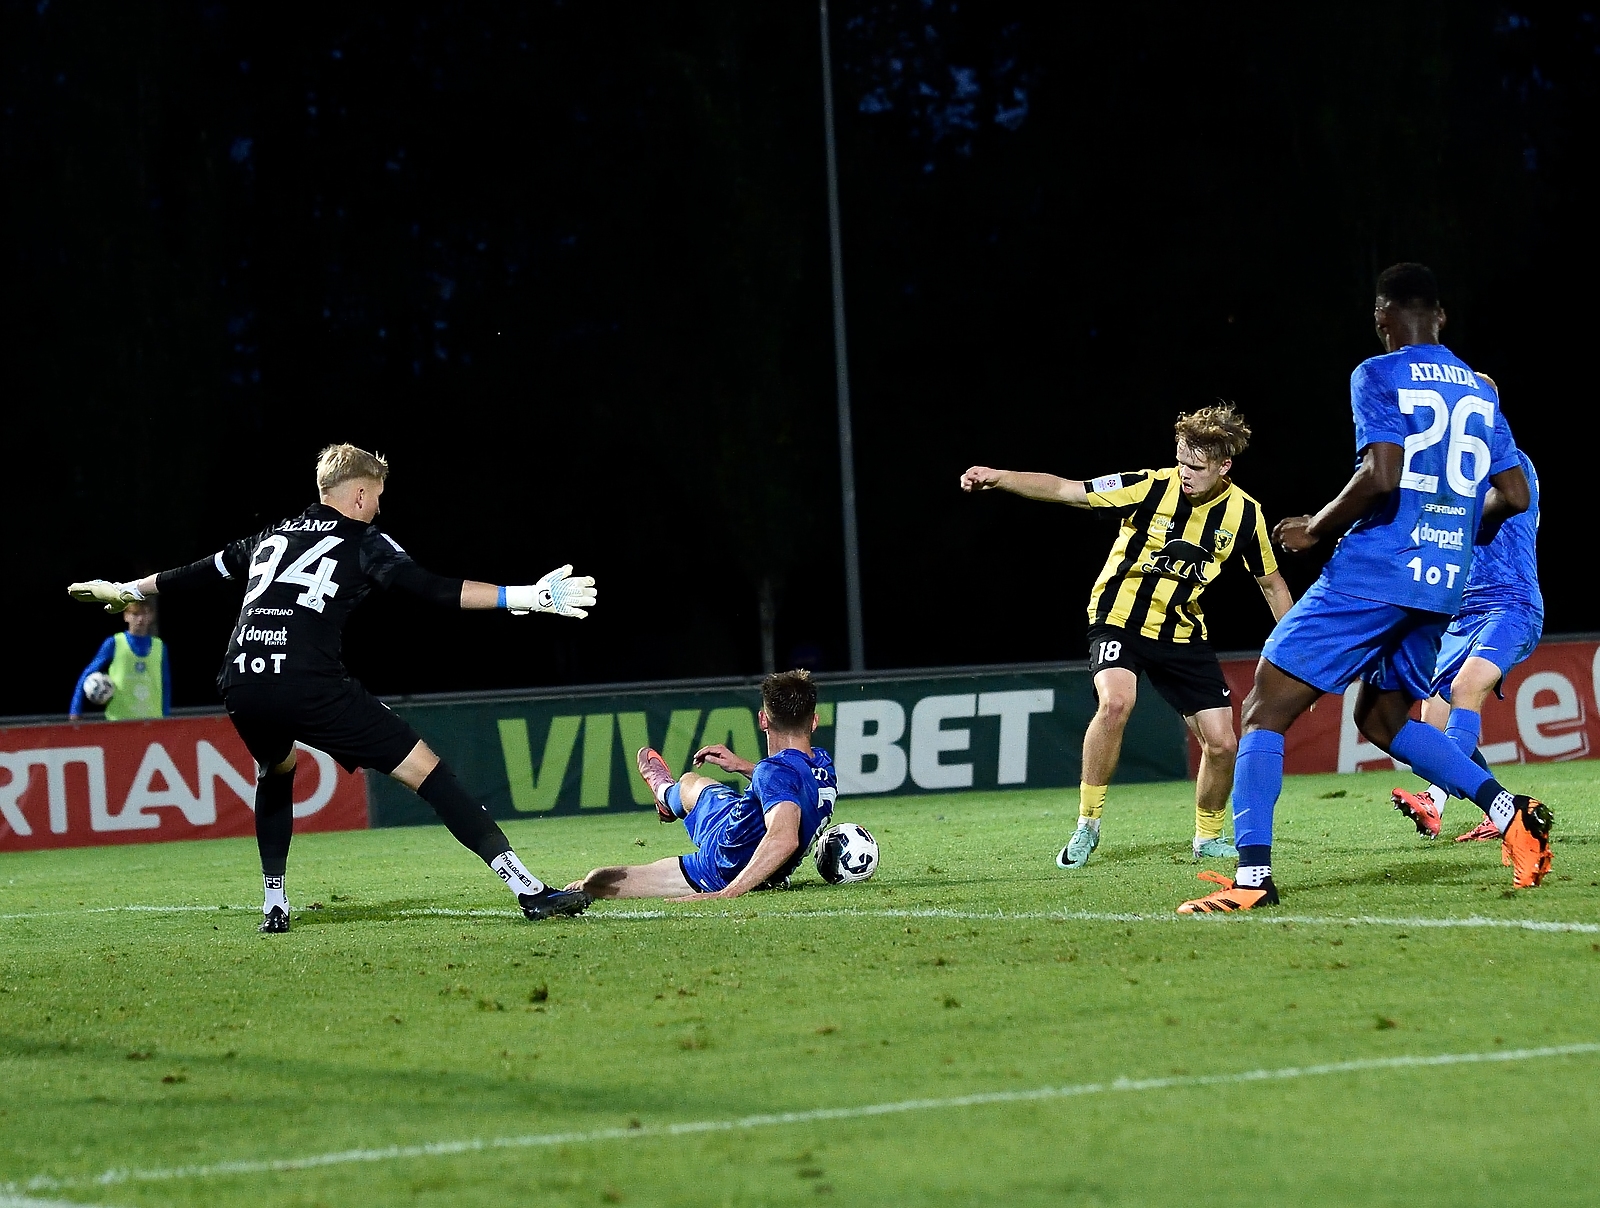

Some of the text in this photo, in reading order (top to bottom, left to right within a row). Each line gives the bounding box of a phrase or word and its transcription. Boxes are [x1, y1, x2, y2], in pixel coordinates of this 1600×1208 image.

[1410, 363, 1479, 390] ATANDA
[1397, 388, 1495, 498] 26
[1421, 522, 1464, 549] dorpat
[242, 534, 345, 614] 94
[245, 625, 288, 646] dorpat
[1097, 640, 1122, 665] 18
[497, 688, 1054, 812] VIVABET
[265, 876, 281, 889] FS
